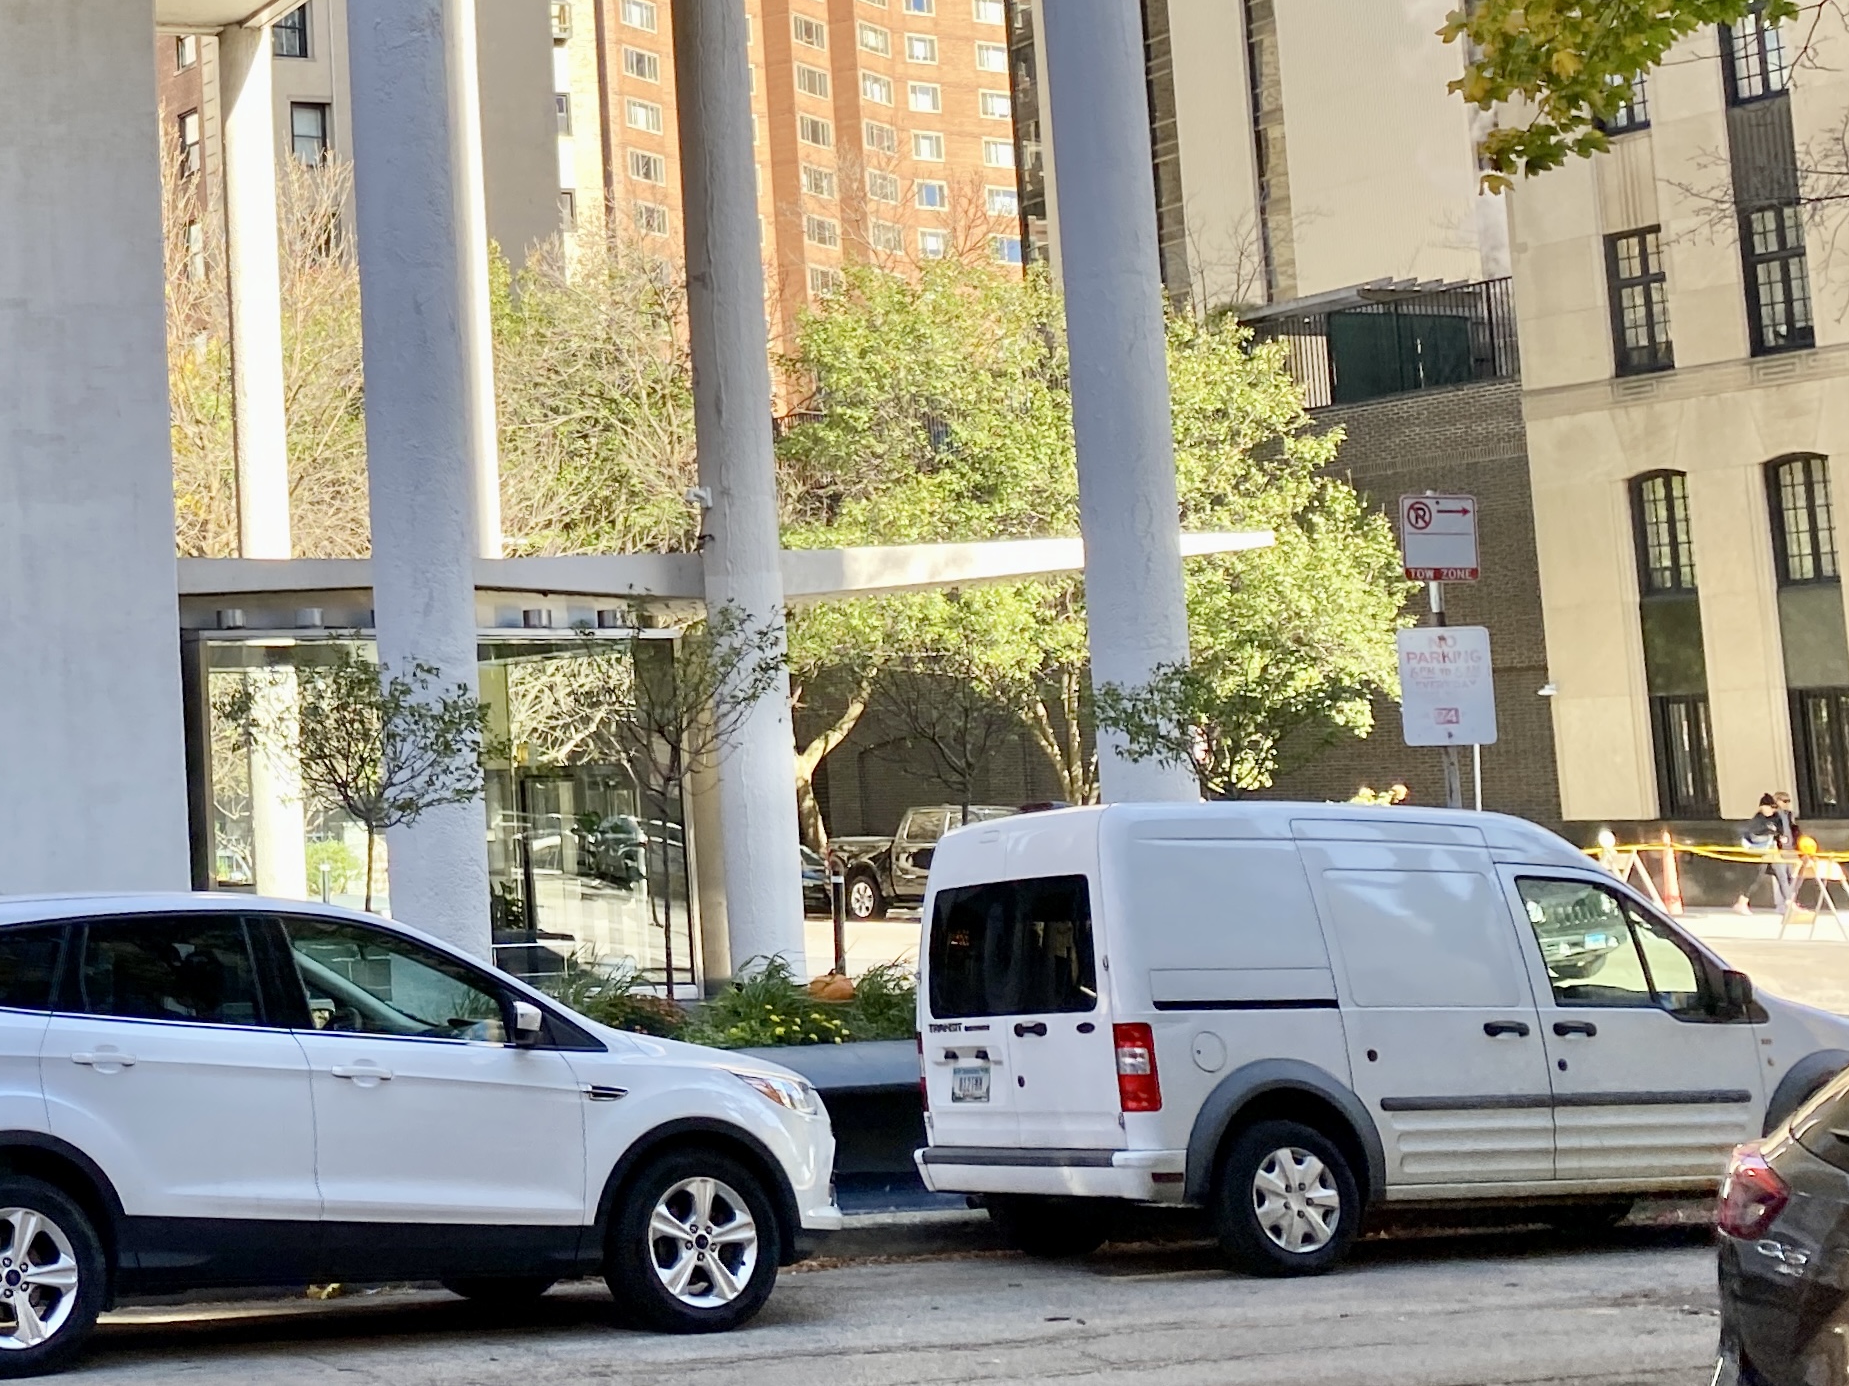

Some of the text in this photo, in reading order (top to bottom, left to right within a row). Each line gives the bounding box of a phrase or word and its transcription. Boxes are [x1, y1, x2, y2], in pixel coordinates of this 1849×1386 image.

[1410, 568, 1472, 579] TOW ZONE
[1427, 634, 1458, 648] NO
[1406, 649, 1482, 664] PARKING
